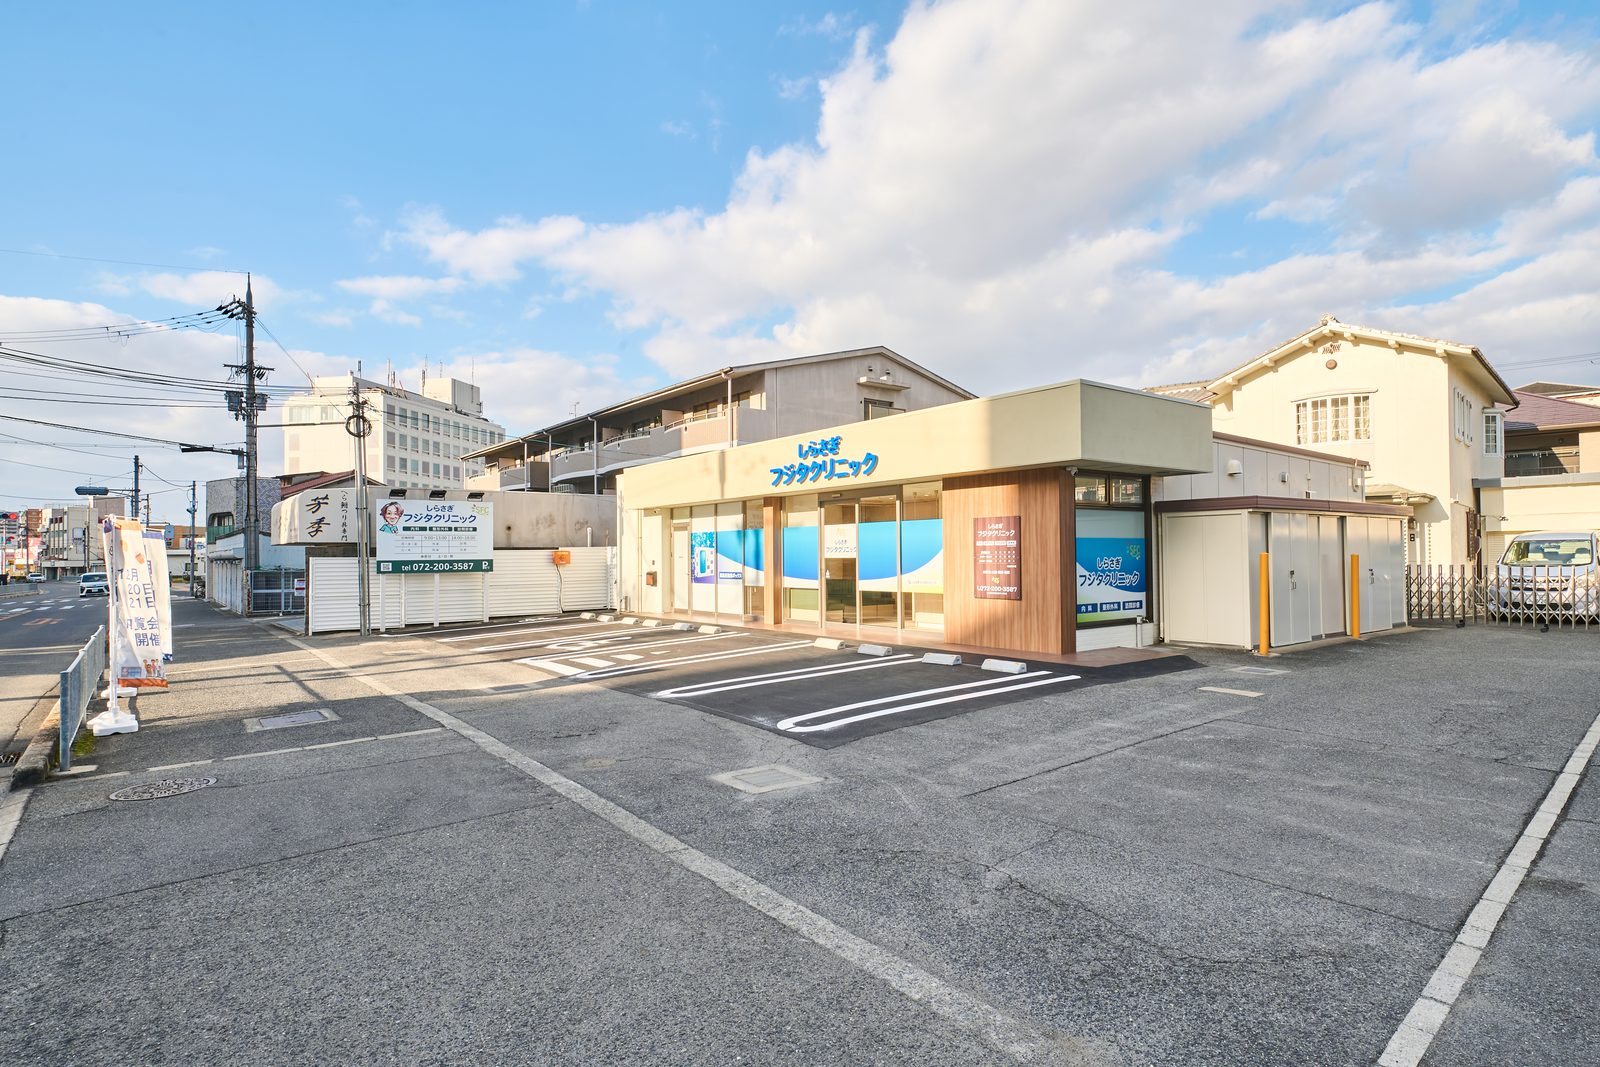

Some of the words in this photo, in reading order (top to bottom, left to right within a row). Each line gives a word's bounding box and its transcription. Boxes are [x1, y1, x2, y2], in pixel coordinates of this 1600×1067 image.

[798, 436, 842, 459] しらさぎ
[770, 452, 878, 487] フジタクリニック
[426, 504, 455, 512] しらさぎ
[403, 513, 477, 523] フジタクリニック
[977, 529, 1015, 537] フジタクリニック
[412, 562, 474, 571] 072-200-3587
[1096, 557, 1122, 570] しらさぎ
[1078, 570, 1140, 587] フジタクリニック
[135, 633, 160, 646] 開催
